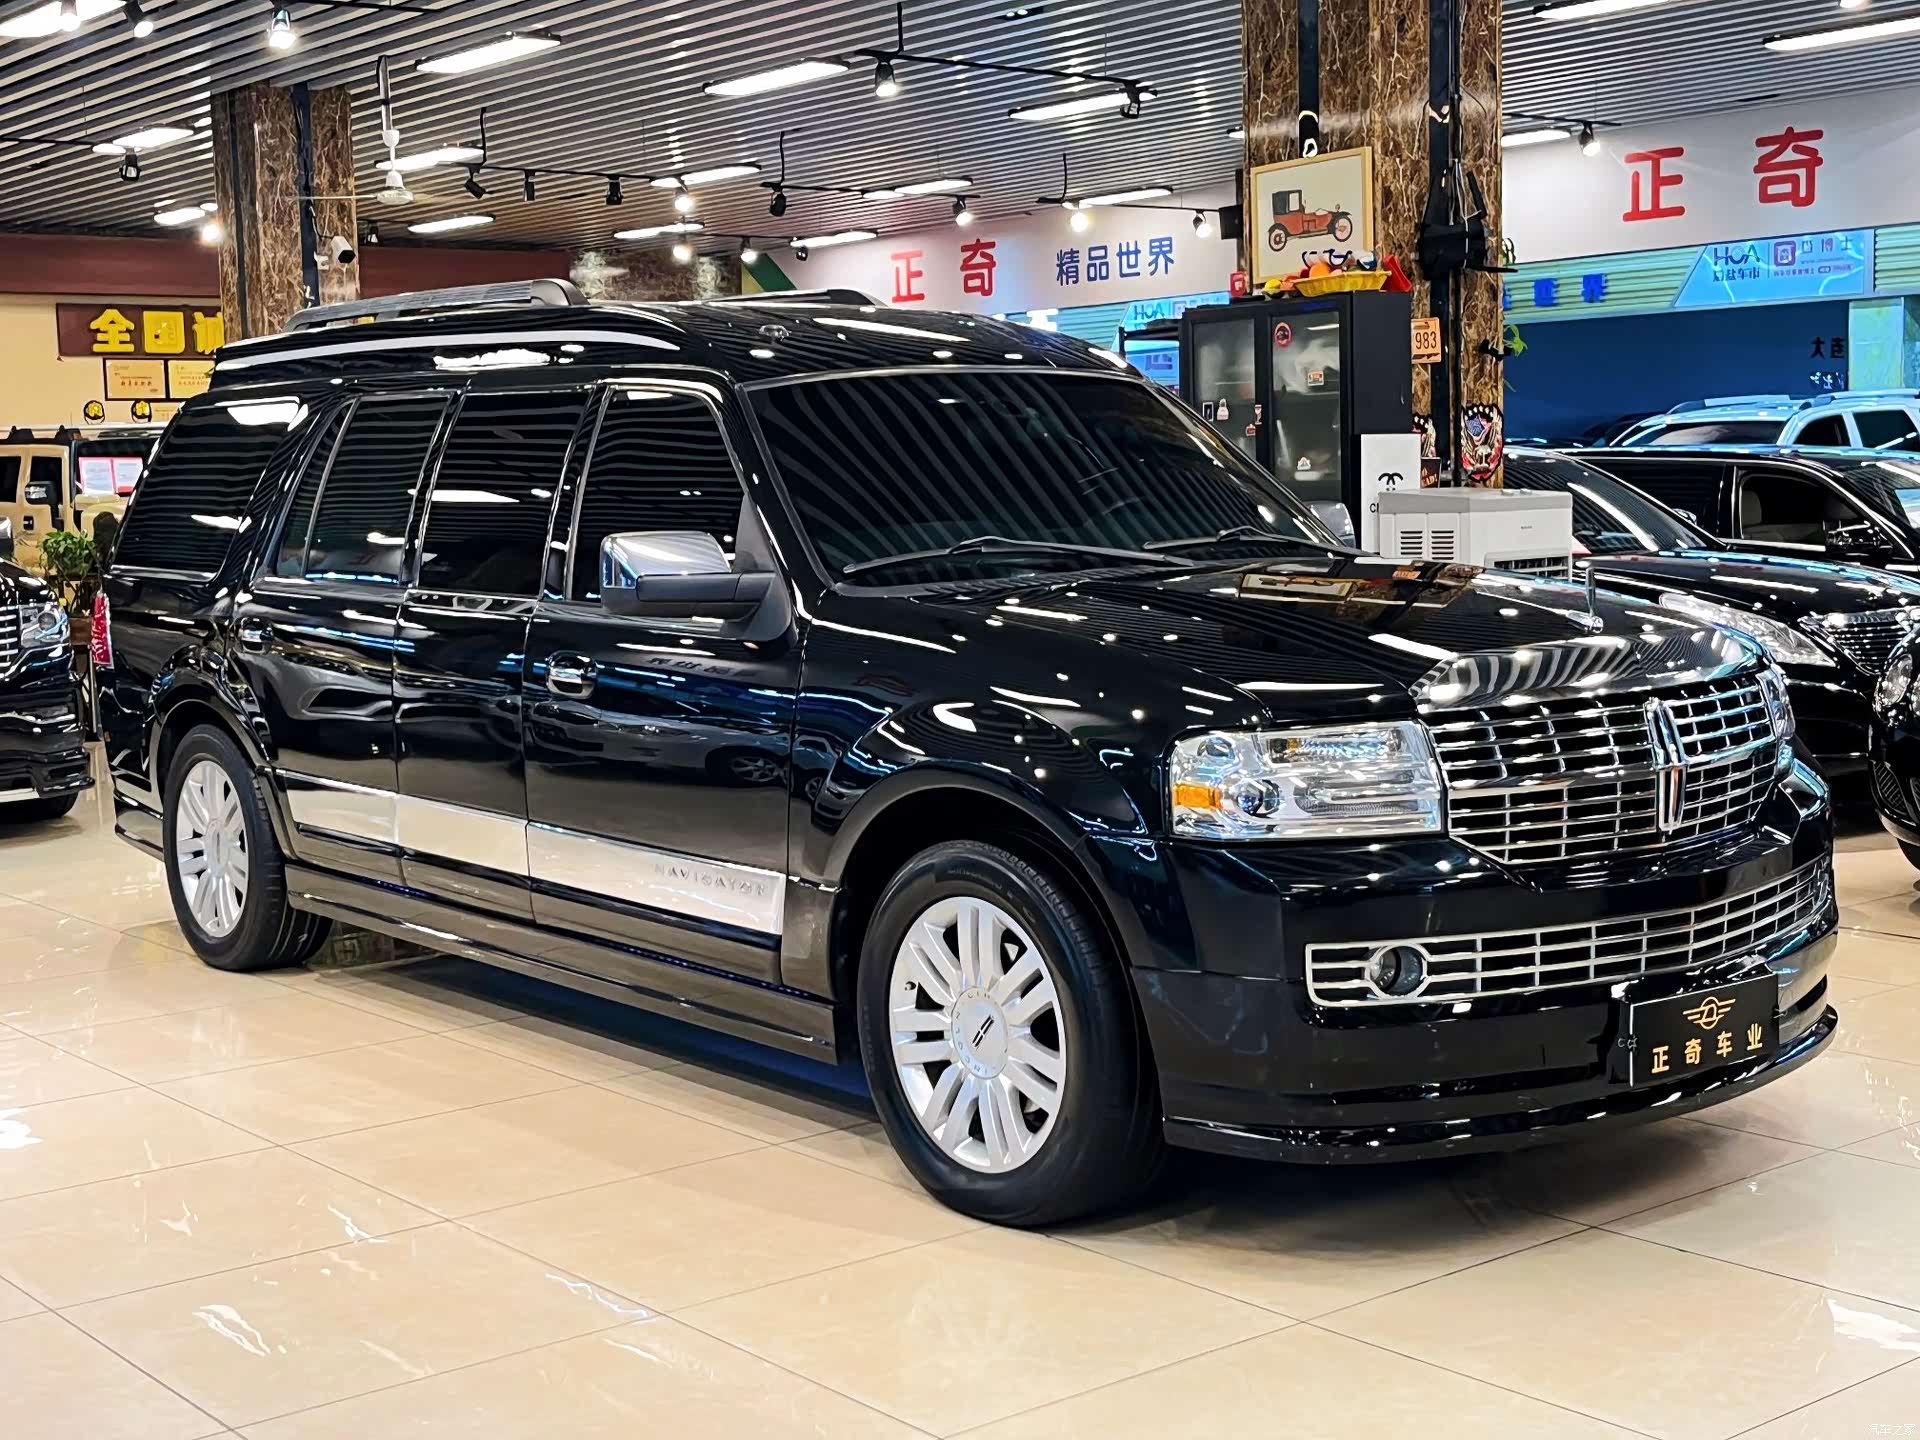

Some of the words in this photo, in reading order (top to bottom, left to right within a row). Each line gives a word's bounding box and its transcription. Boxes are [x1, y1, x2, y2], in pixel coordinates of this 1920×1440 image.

[1622, 126, 1824, 222] 正奇
[891, 238, 997, 303] 正奇
[1056, 236, 1175, 287] 精品世界
[1415, 331, 1437, 350] 983
[1651, 1023, 1763, 1074] 正奇车业
